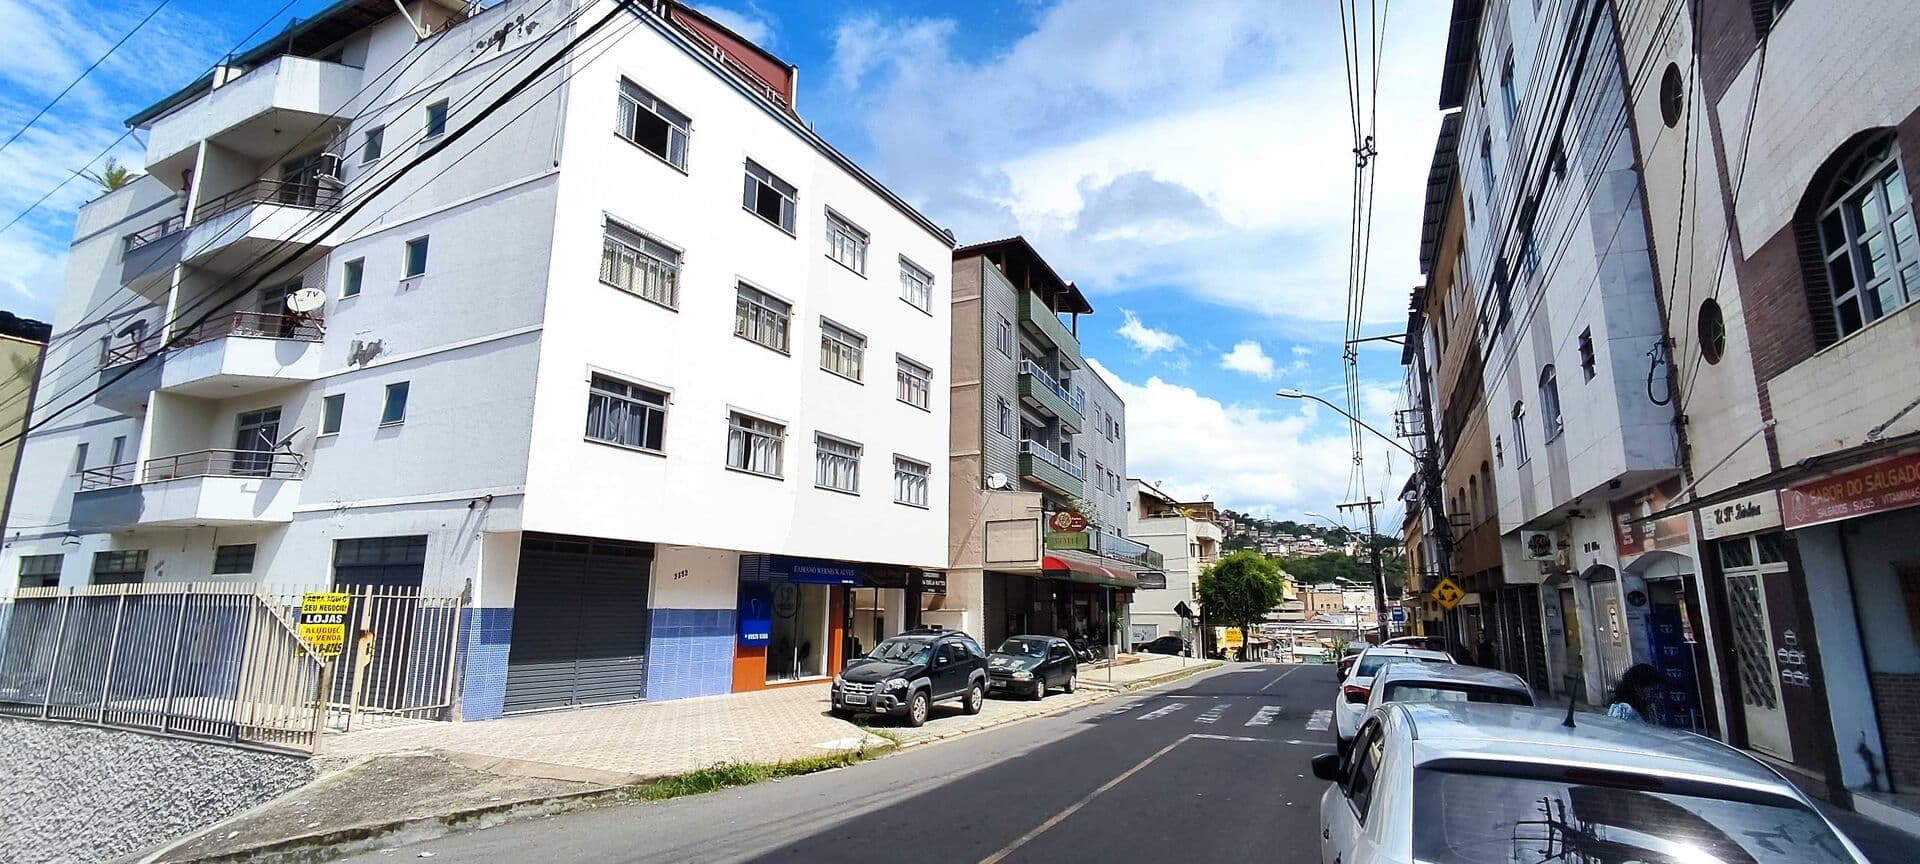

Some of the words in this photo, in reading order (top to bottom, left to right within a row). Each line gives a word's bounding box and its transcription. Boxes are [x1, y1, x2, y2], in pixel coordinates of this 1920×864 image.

[306, 290, 320, 298] TV
[1809, 483, 1844, 505] SABOR
[1846, 478, 1863, 497] DO
[1817, 502, 1848, 519] SALGADOS
[1852, 497, 1875, 512] SUCOS
[303, 604, 318, 612] SEU
[305, 614, 343, 624] LOJAS
